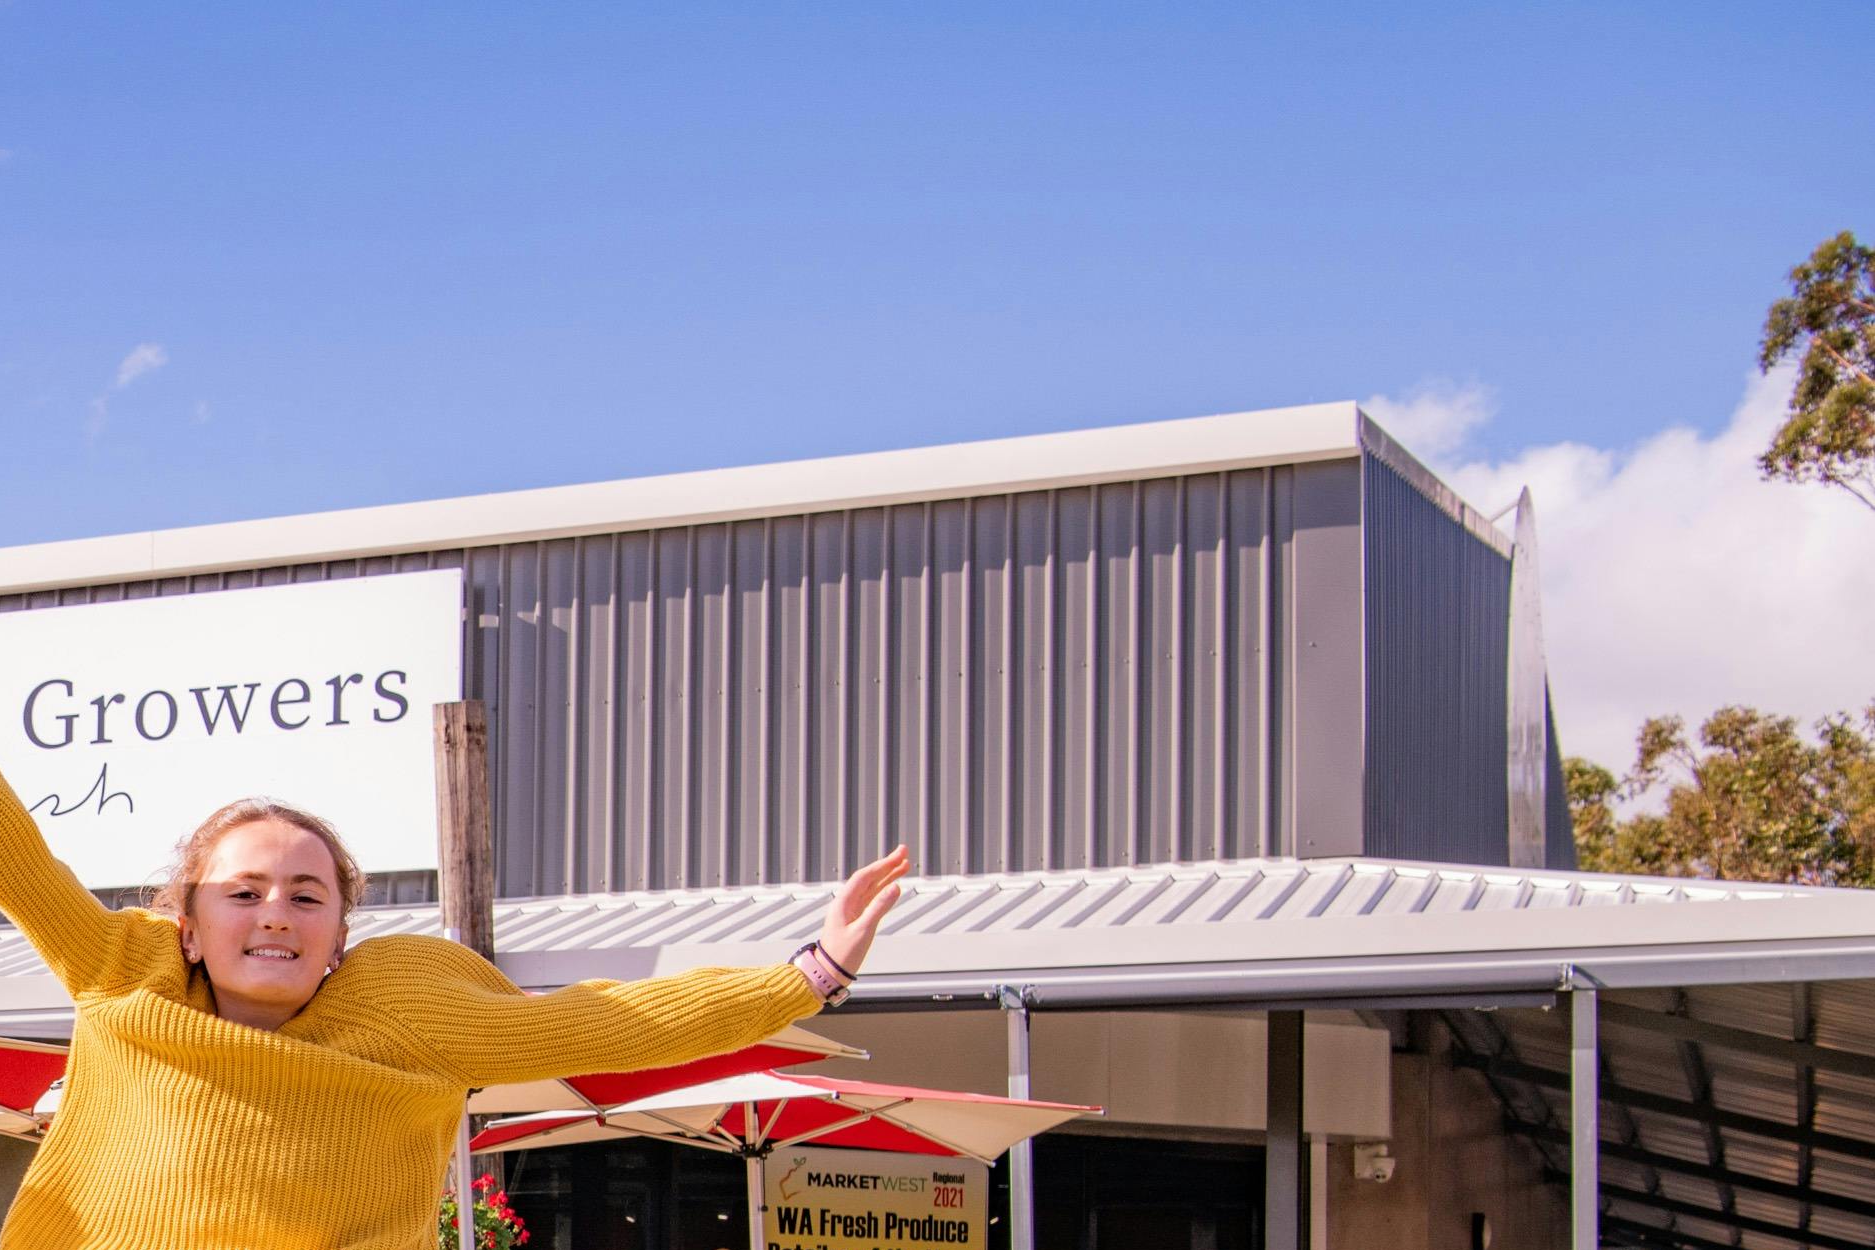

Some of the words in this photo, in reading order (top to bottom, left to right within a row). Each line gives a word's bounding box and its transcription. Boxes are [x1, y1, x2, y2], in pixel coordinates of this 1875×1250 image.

[23, 669, 409, 749] Growers
[807, 1171, 928, 1193] MARKETWEST
[932, 1171, 966, 1185] Regional
[933, 1186, 964, 1208] 2021
[777, 1206, 813, 1236] WA
[819, 1208, 878, 1239] Fresh
[885, 1211, 969, 1243] Produce
